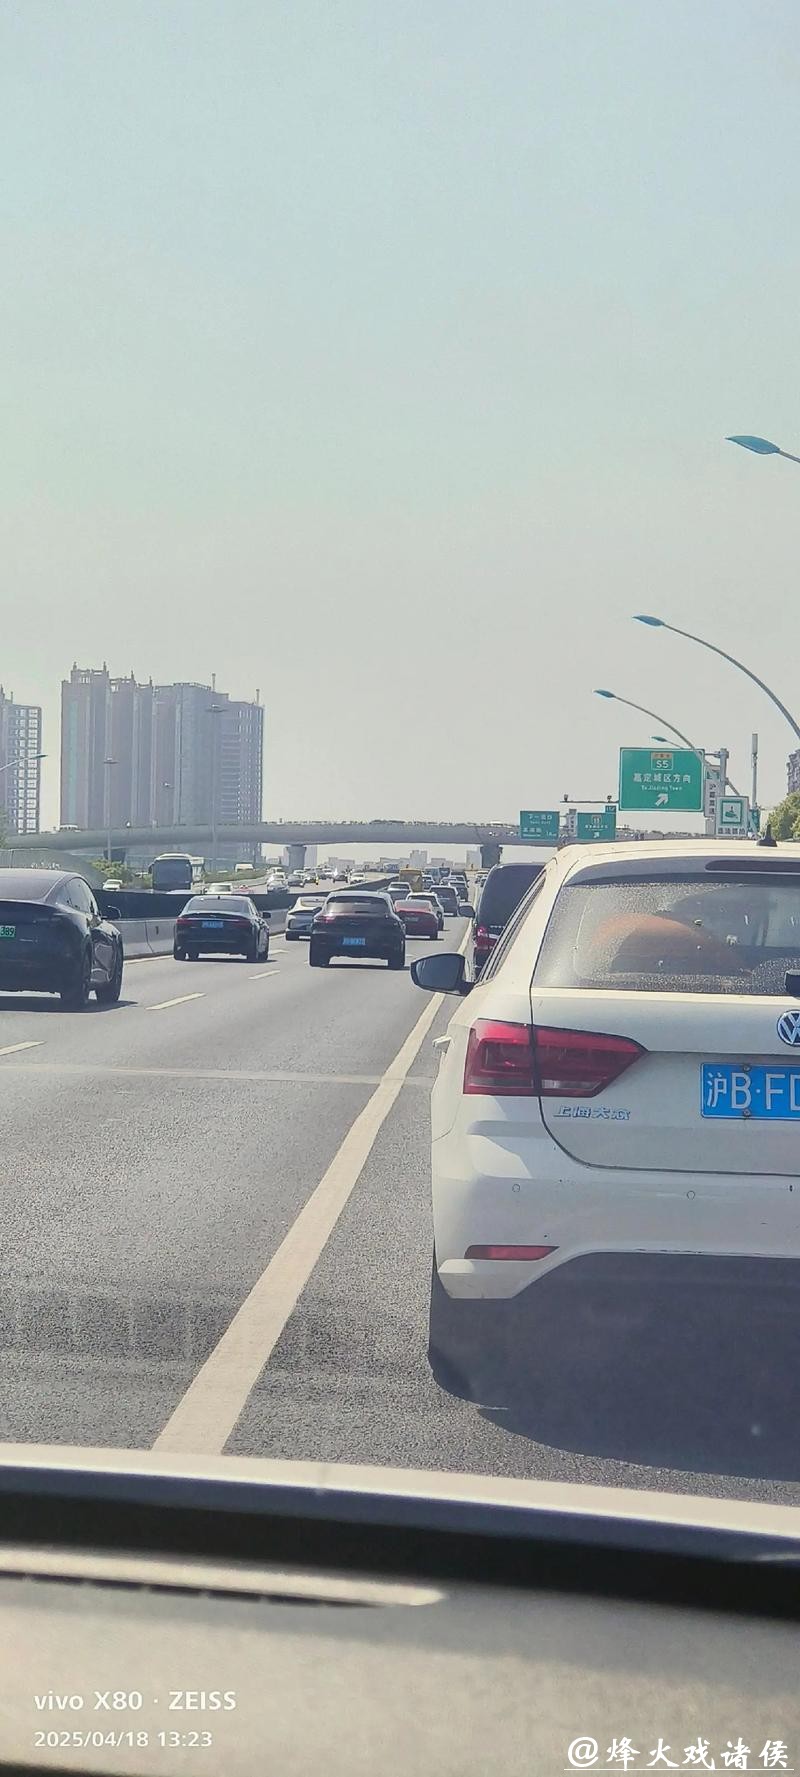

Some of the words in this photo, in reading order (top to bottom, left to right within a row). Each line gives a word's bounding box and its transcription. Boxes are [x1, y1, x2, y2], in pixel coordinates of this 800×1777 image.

[656, 760, 669, 769] S5
[553, 1104, 631, 1121] 上海大众
